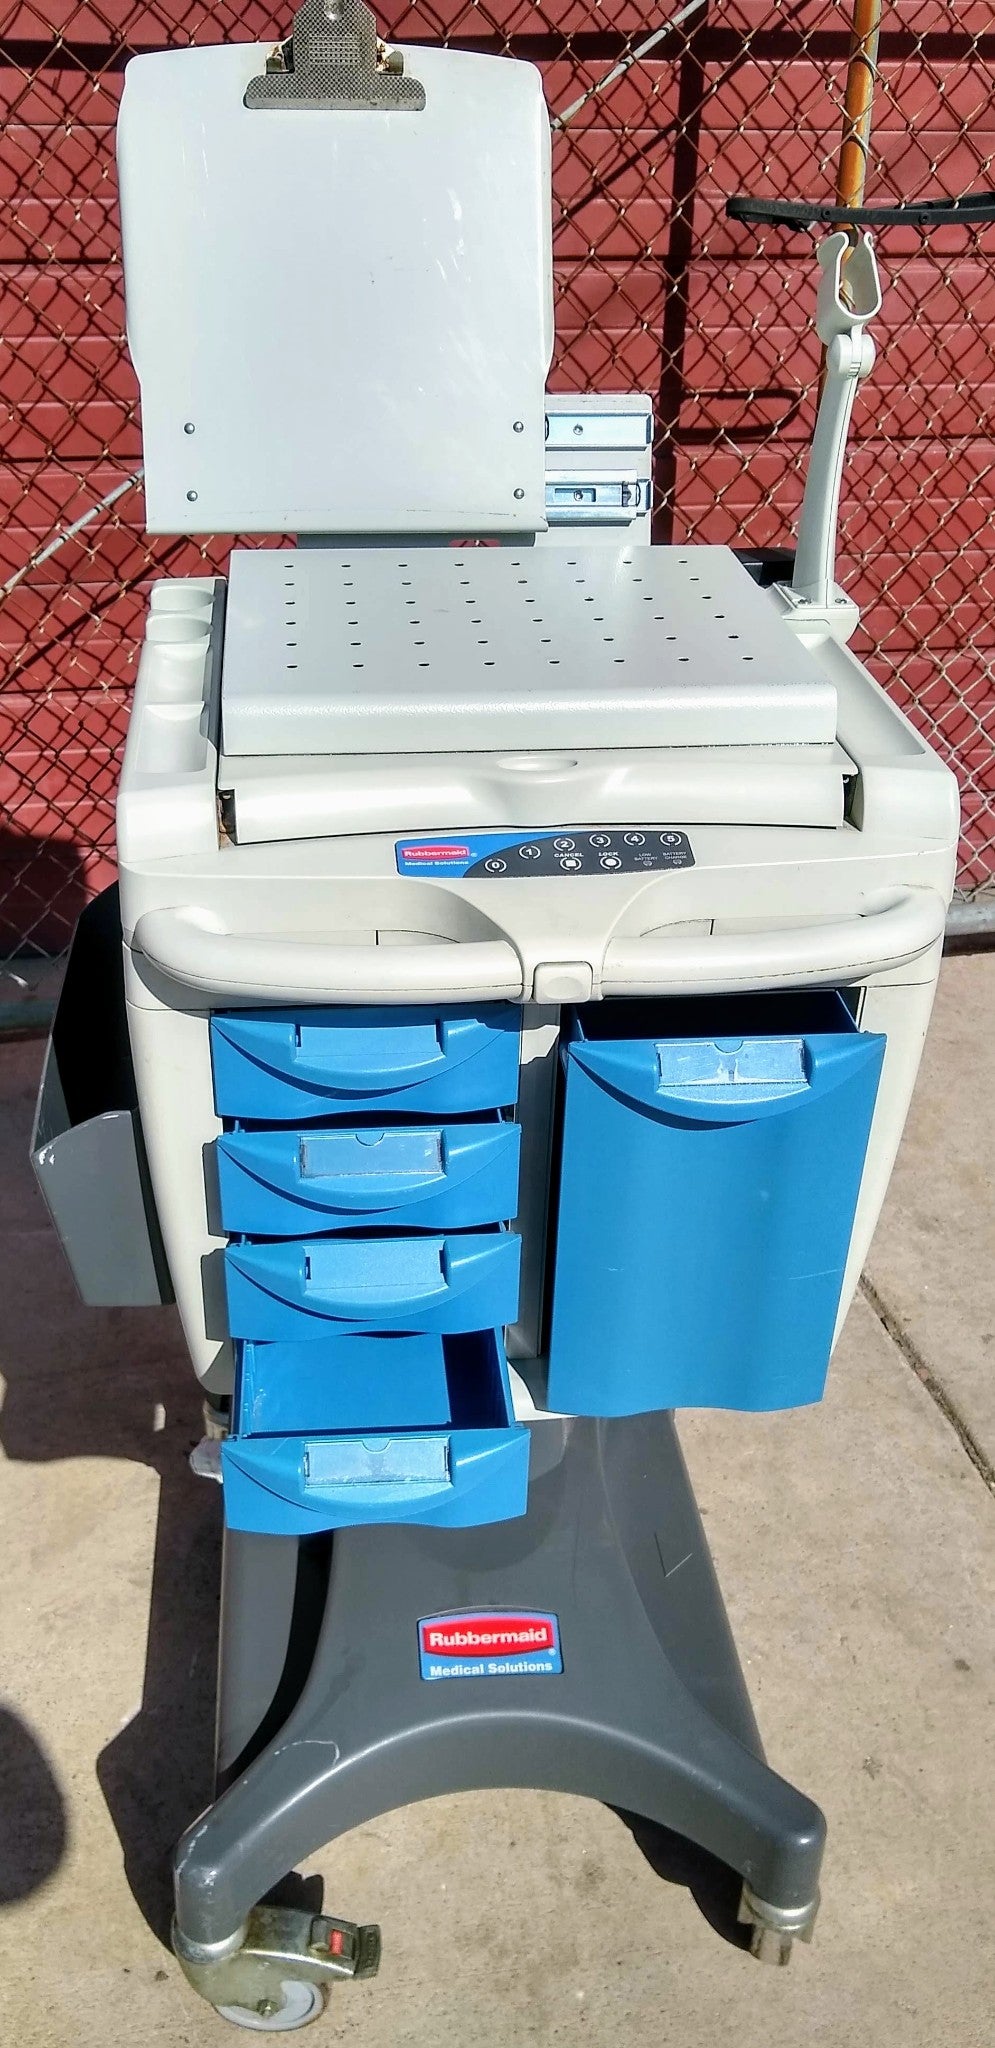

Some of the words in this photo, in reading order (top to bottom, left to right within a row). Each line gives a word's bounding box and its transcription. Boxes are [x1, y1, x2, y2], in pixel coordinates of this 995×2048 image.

[596, 836, 604, 844] 3
[404, 848, 467, 857] Rubbermaid
[525, 848, 533, 856] 1
[429, 1627, 548, 1647] Rubbermaid
[430, 1664, 485, 1677] Medical
[488, 1661, 553, 1675] Solutions
